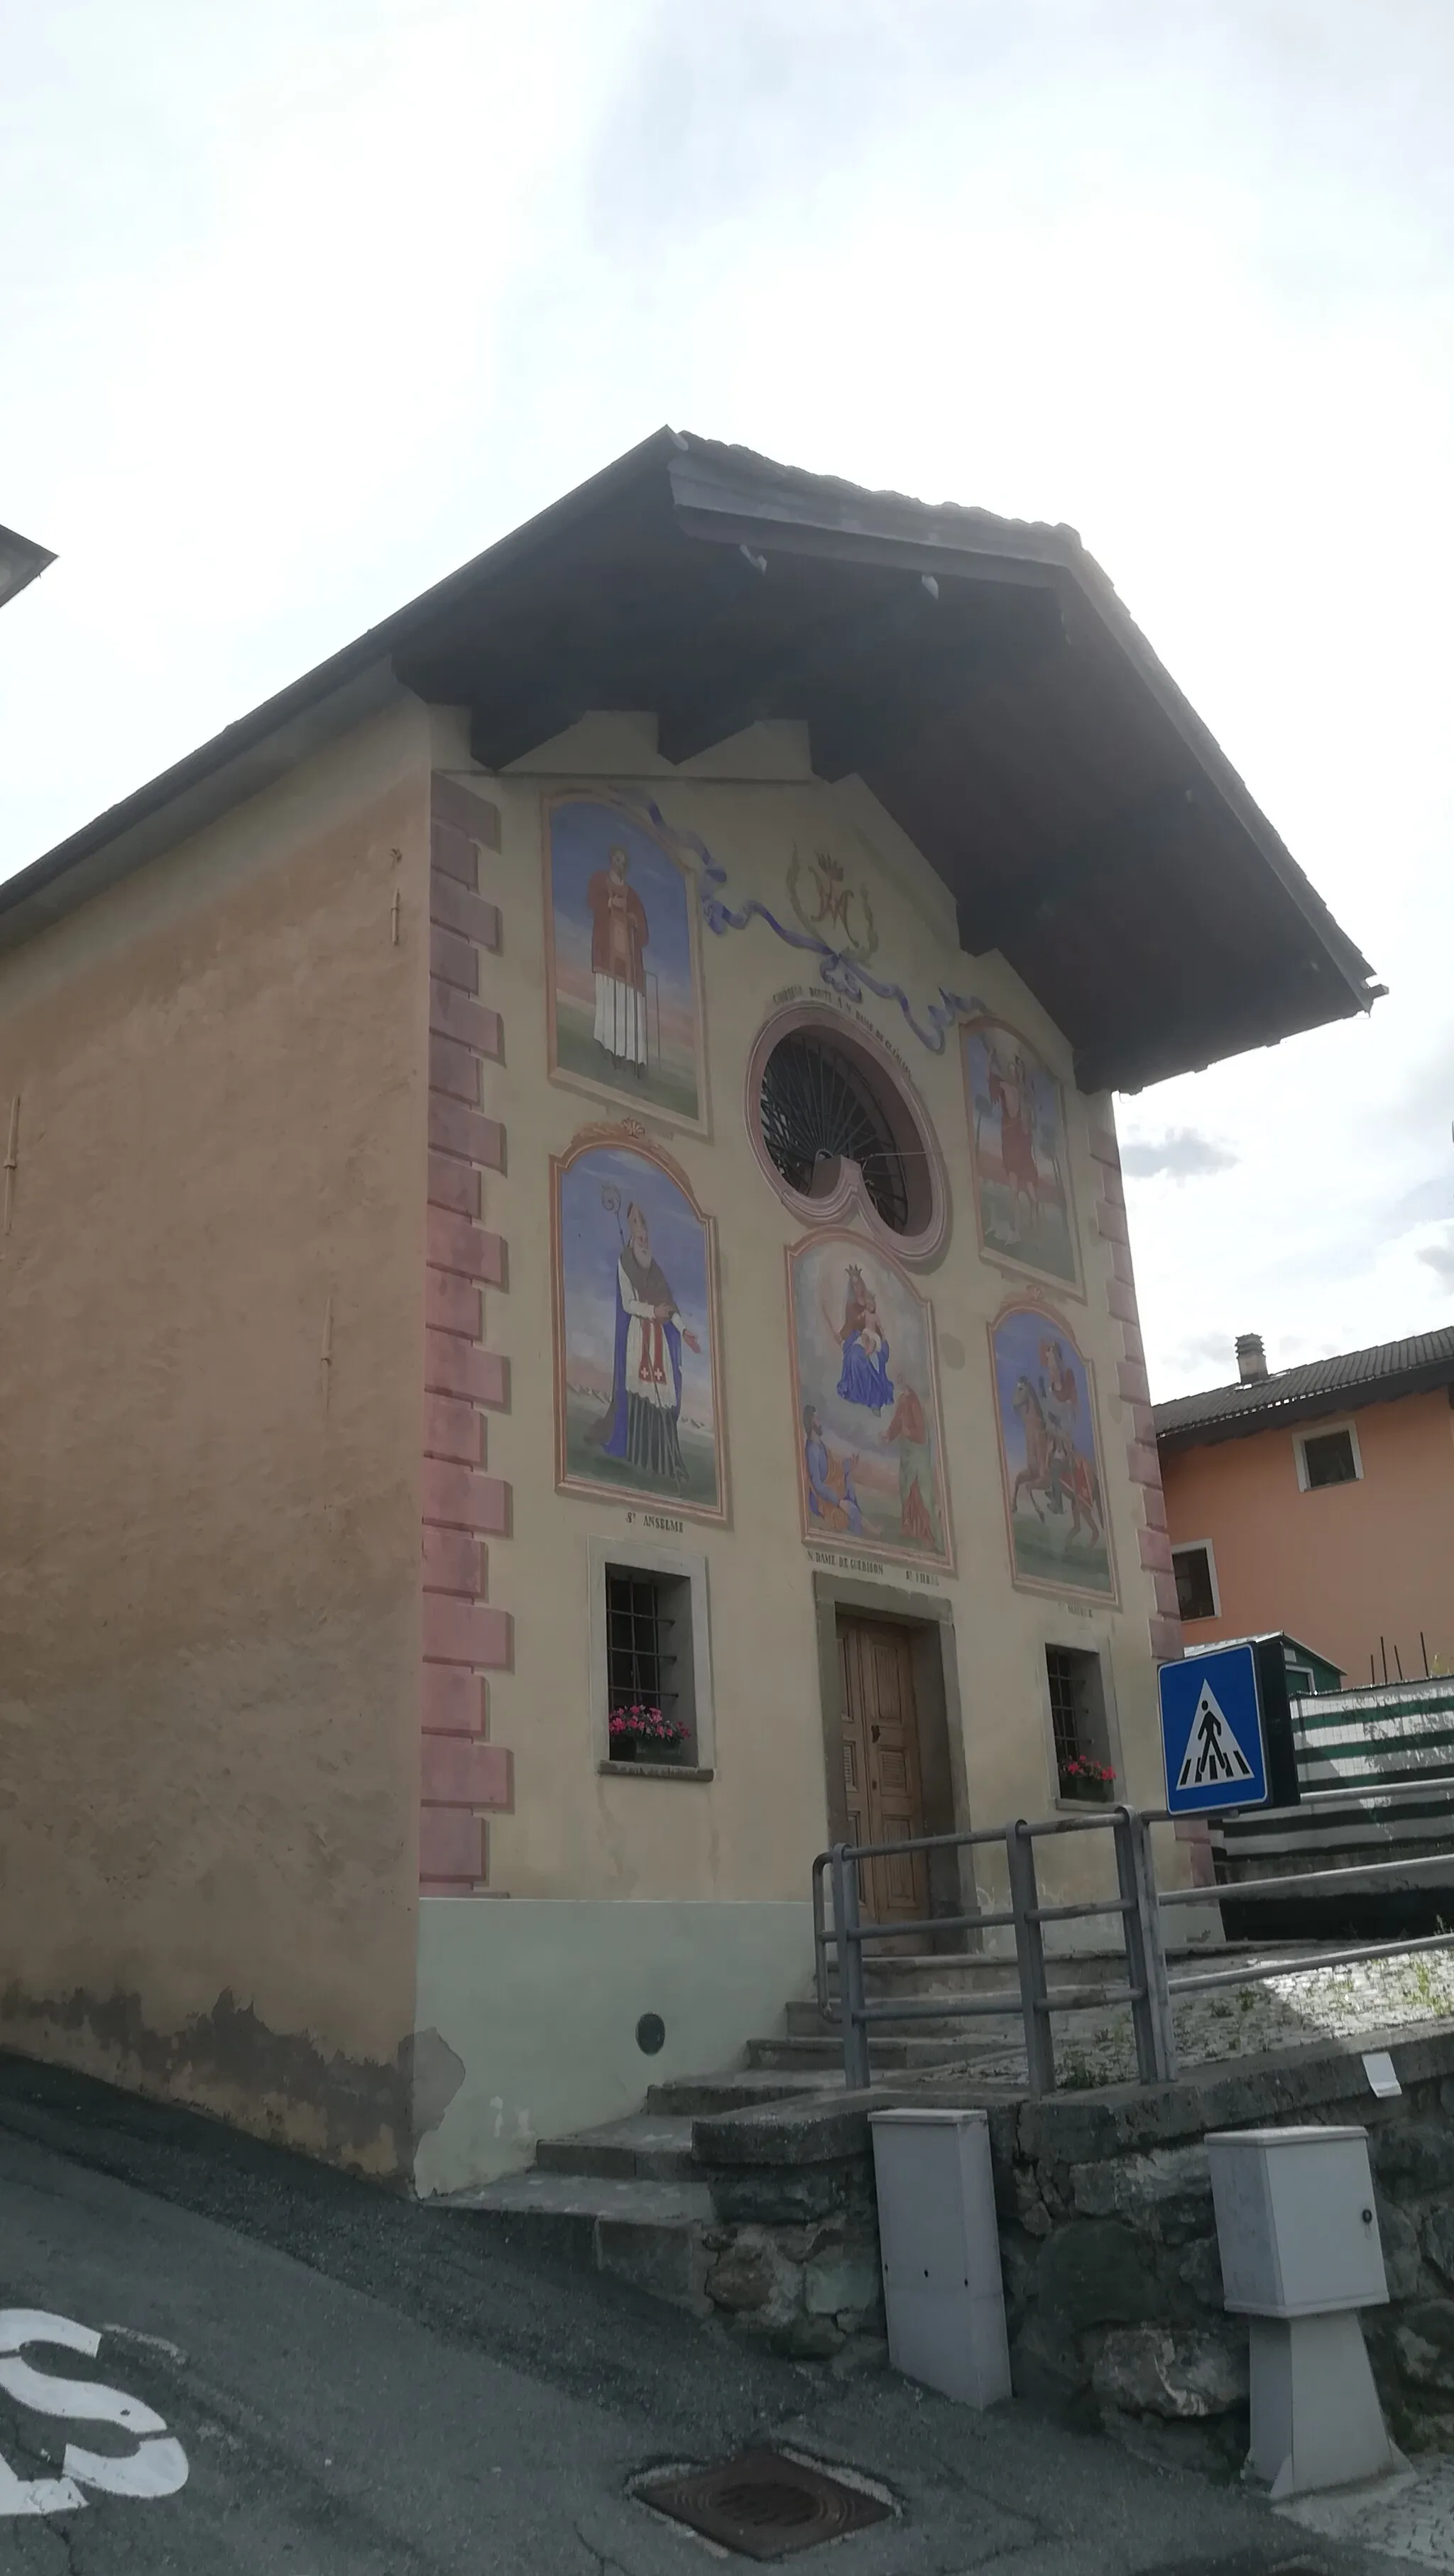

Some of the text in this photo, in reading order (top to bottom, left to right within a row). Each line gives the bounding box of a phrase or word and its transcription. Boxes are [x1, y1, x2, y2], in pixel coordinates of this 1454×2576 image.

[643, 1515, 684, 1533] ANSELME
[815, 1551, 835, 1566] DAME
[838, 1556, 848, 1568] DE
